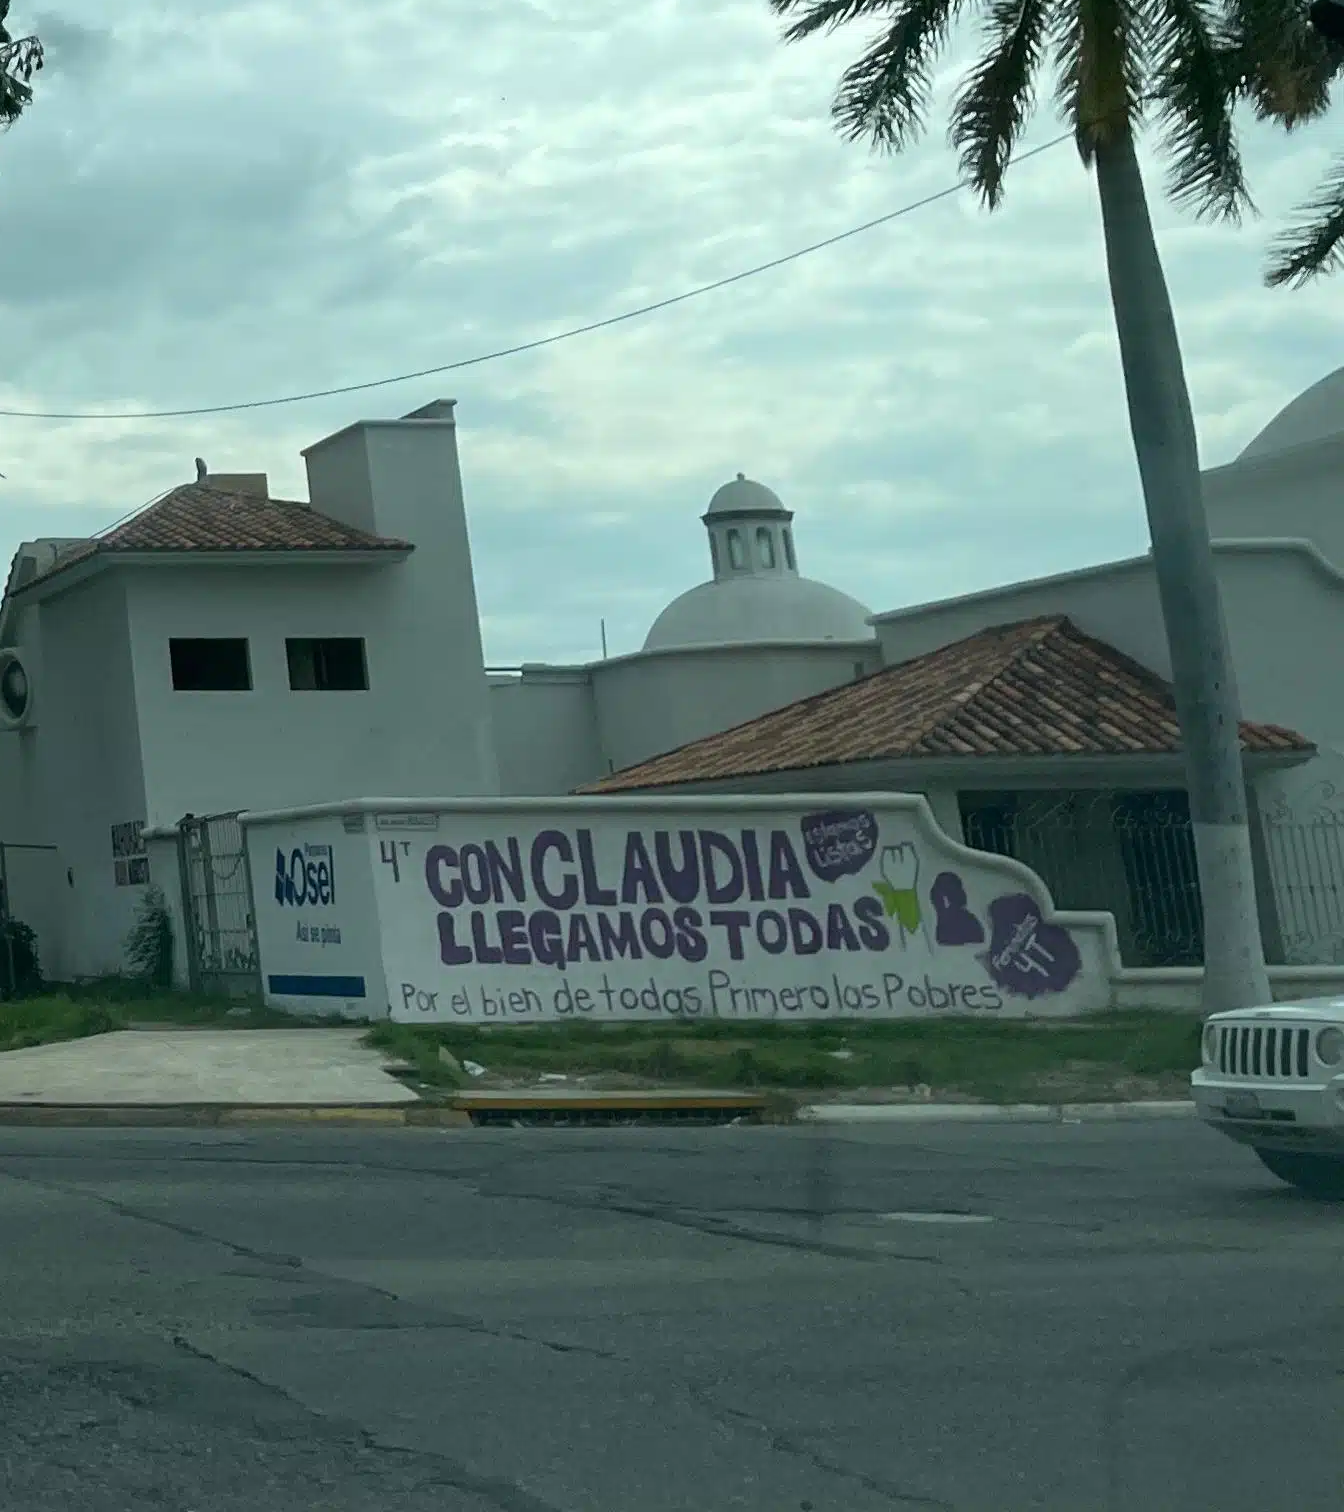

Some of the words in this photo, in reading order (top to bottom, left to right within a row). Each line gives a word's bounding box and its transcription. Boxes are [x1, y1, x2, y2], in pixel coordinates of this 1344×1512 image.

[291, 844, 335, 907] Osel
[380, 840, 411, 883] 4T
[425, 836, 527, 909] CON
[530, 828, 811, 911] CLAUDIA
[437, 906, 709, 971] LLEGAMOS
[710, 896, 891, 961] TODAS
[401, 983, 440, 1013] Por
[451, 986, 473, 1016] el
[481, 984, 543, 1017] bien
[553, 977, 596, 1015] de
[598, 973, 703, 1015] todas
[708, 969, 830, 1016] Primero
[882, 972, 1004, 1010] Pobres
